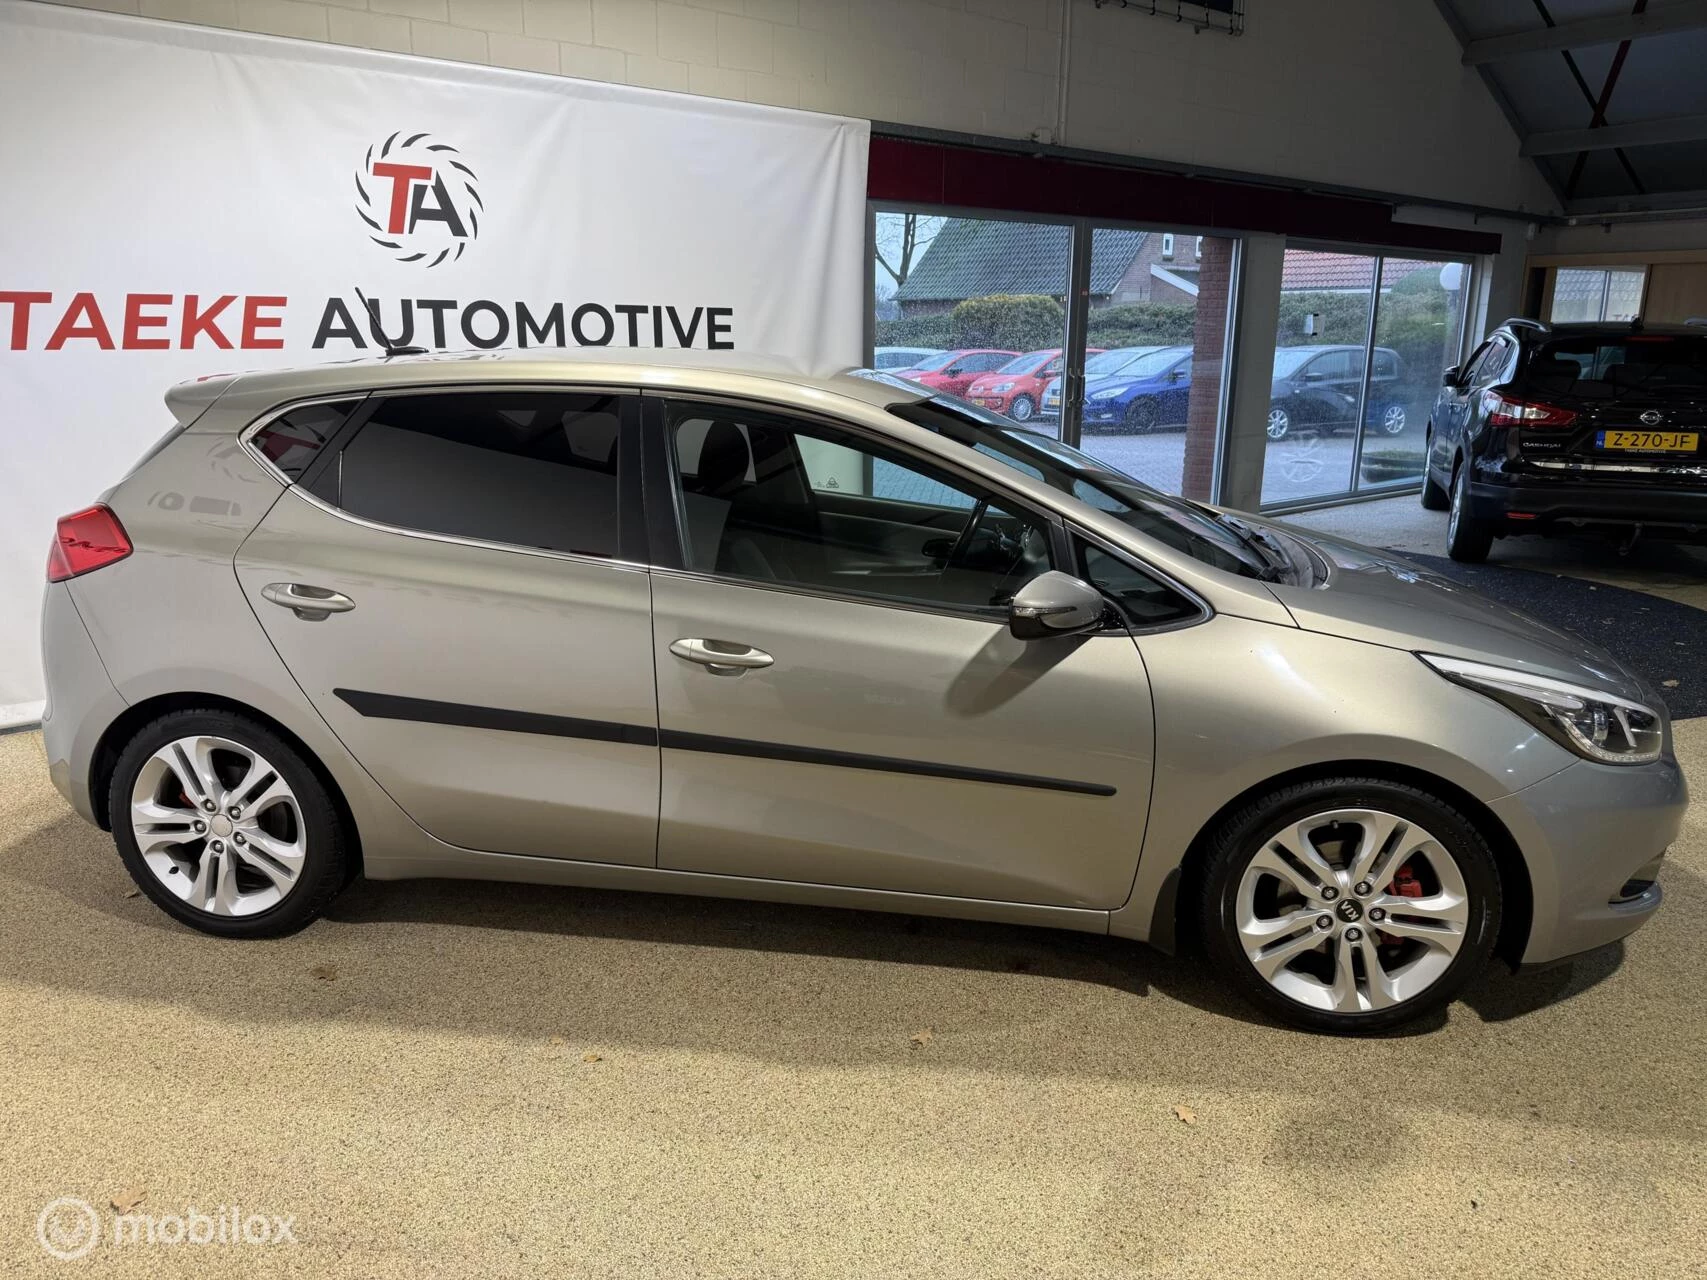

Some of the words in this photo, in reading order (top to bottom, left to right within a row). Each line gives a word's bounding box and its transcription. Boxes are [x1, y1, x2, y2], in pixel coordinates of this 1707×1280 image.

[371, 162, 469, 237] TA
[0, 291, 288, 351] TAEKE
[311, 296, 735, 350] AUTOMOTIVE
[1613, 433, 1691, 448] Z-270-JF
[1341, 901, 1359, 920] KIA
